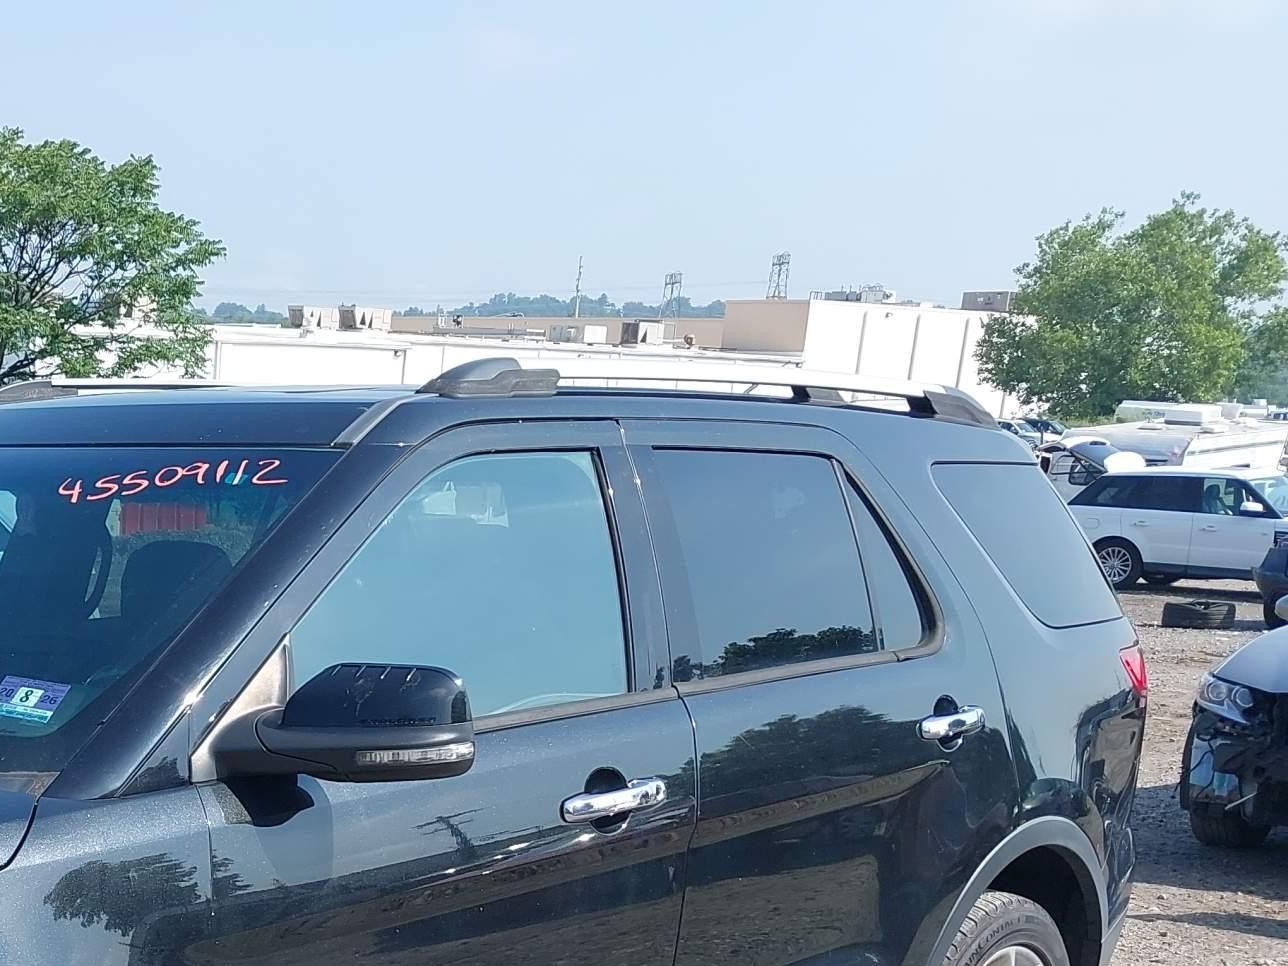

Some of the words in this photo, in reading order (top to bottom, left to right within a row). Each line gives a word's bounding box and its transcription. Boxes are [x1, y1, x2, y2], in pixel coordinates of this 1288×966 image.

[58, 459, 288, 503] 45509112
[0, 687, 15, 699] 20
[19, 689, 34, 703] 8
[40, 694, 59, 705] 26
